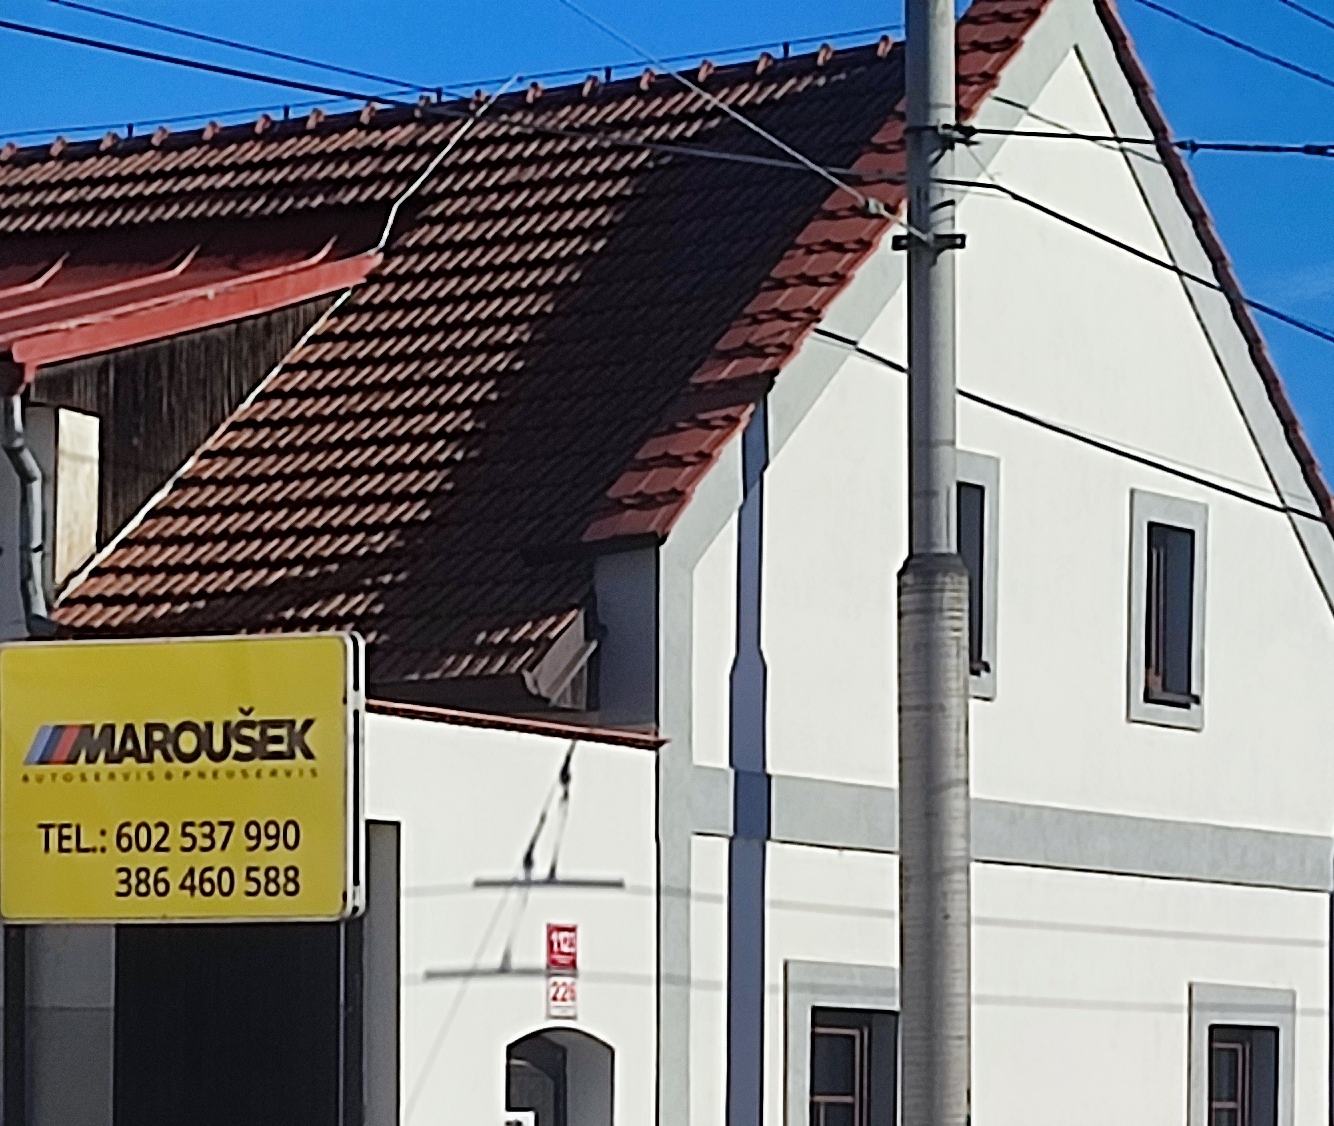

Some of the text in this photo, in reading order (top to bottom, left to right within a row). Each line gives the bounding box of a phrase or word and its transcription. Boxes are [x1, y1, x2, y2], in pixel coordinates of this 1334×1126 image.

[66, 707, 316, 764] MAROUŠEK
[21, 770, 157, 784] AUTOSERVIS
[181, 767, 318, 781] PNEUSERVIS
[36, 819, 301, 854] TEL.: 602 537 990
[114, 865, 301, 898] 386 460 588
